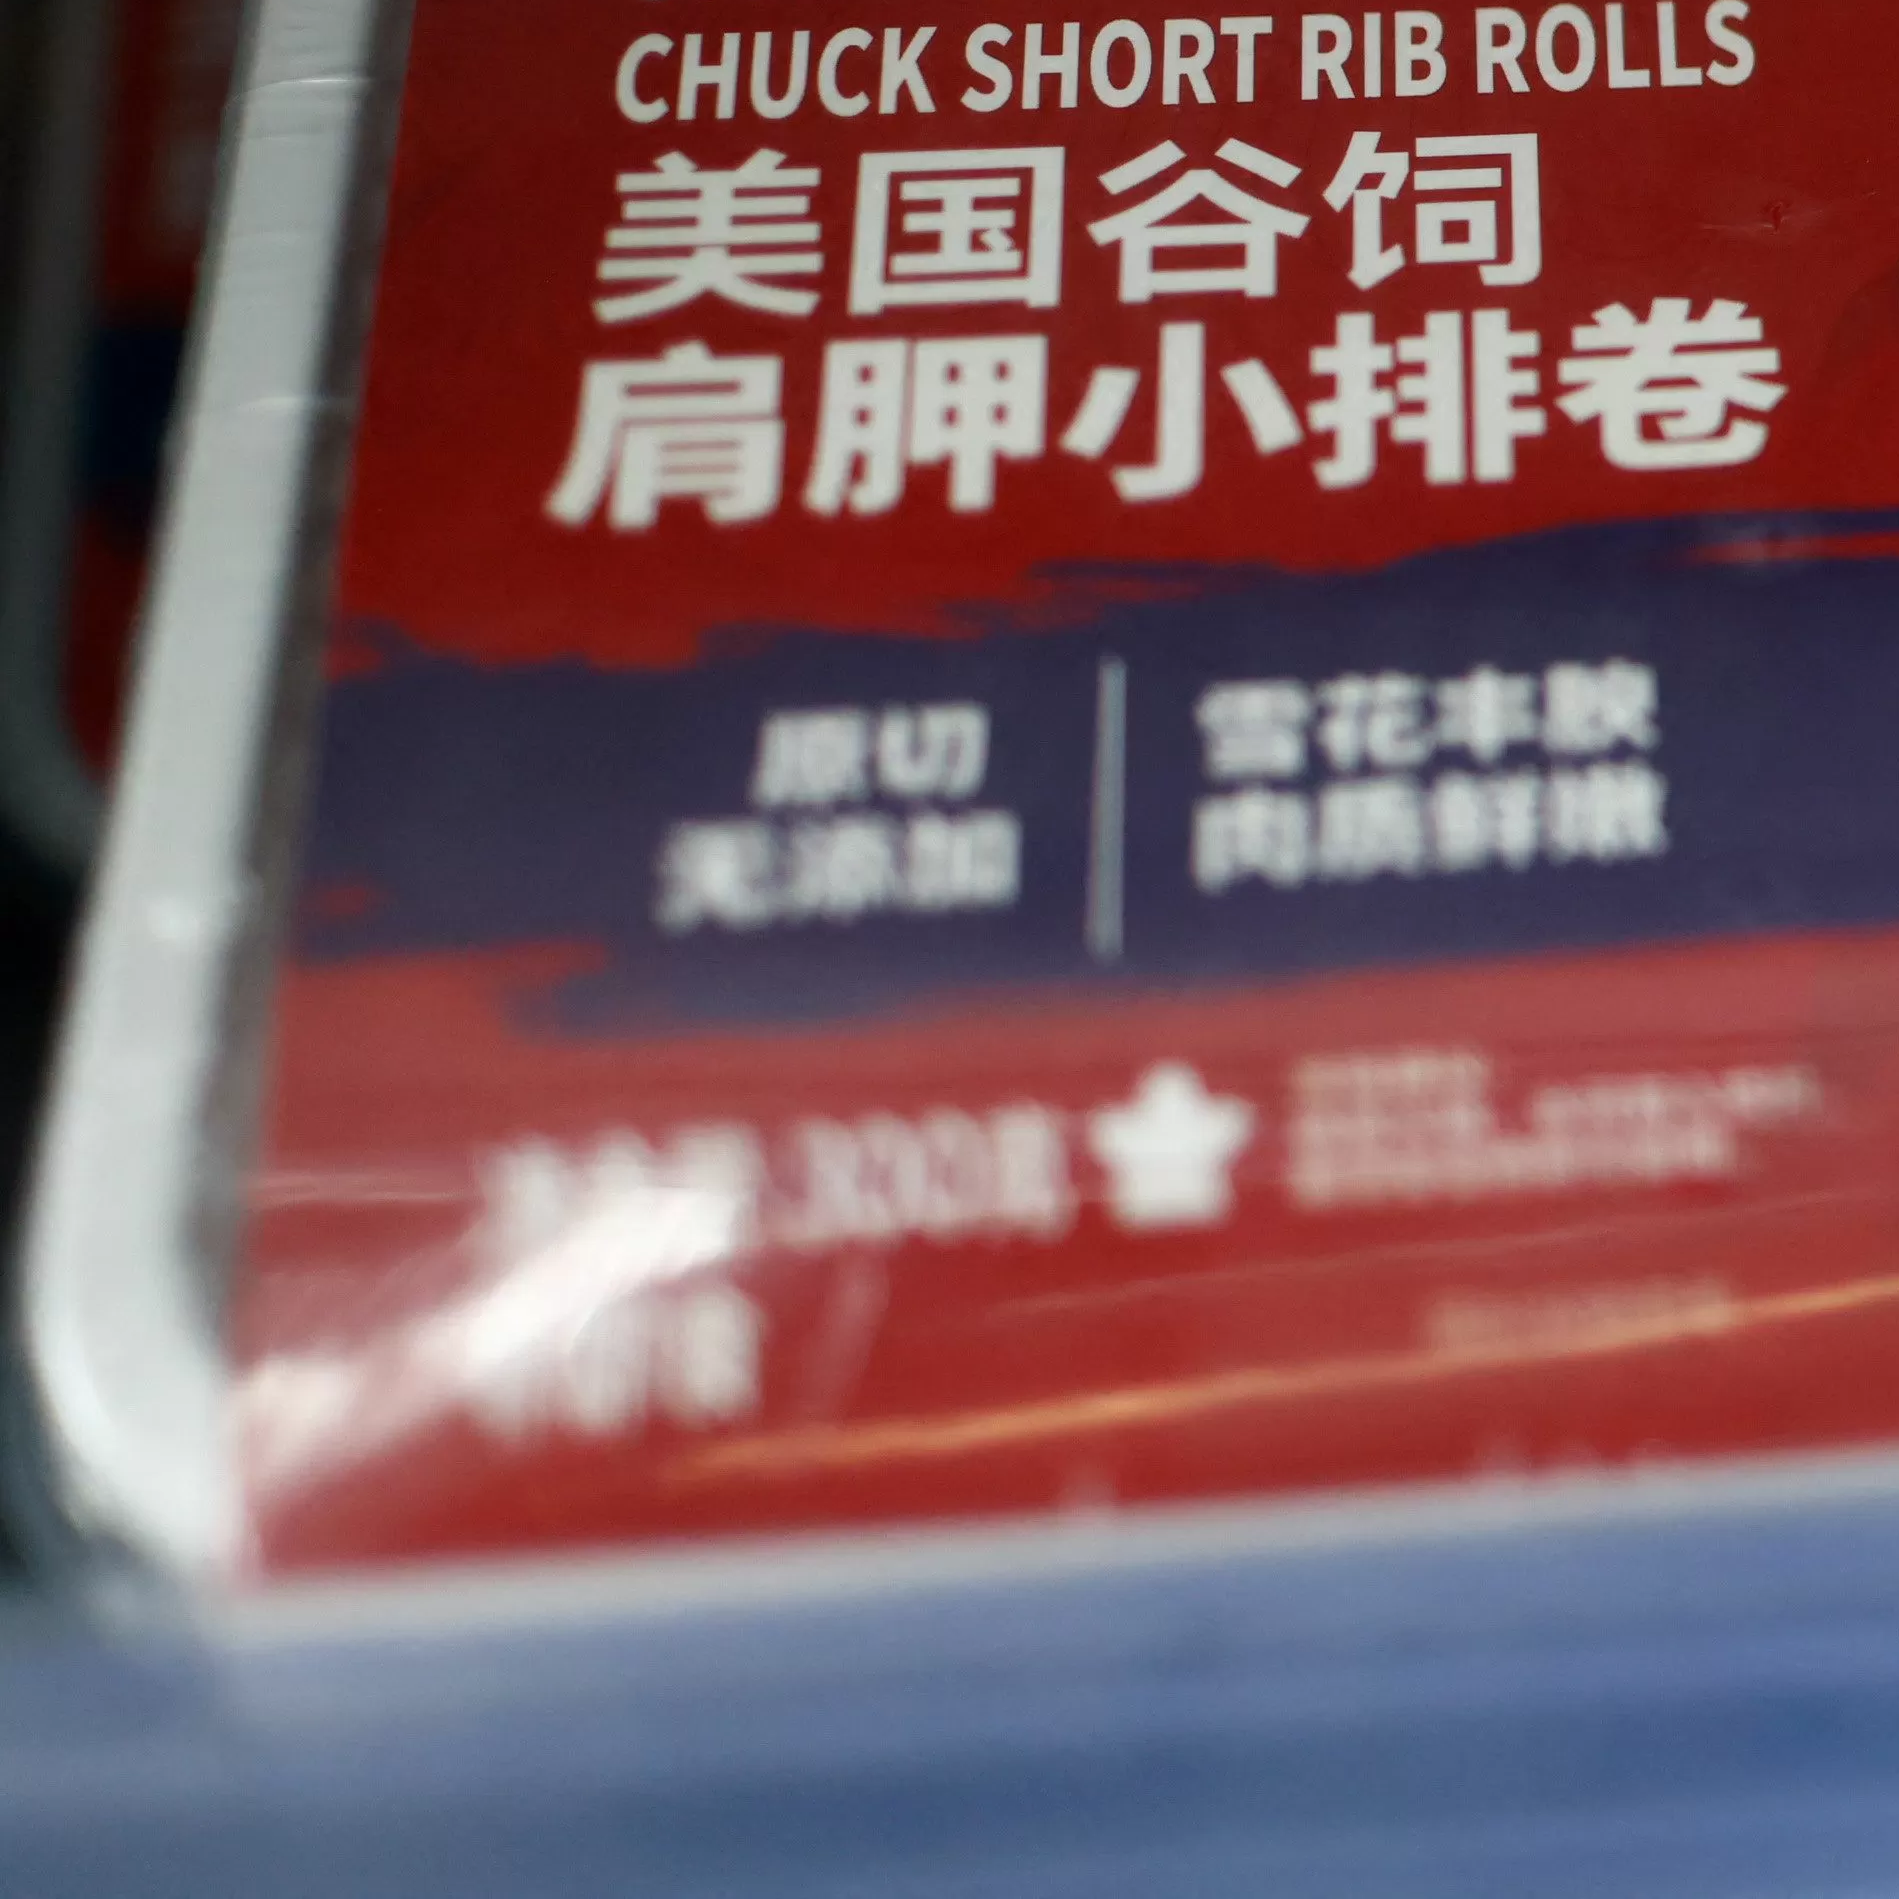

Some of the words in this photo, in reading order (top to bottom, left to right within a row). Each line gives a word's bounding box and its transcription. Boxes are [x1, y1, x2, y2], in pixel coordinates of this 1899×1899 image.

[615, 27, 937, 124] CHUCK
[961, 16, 1274, 113] SHORT
[1300, 10, 1447, 102] RIB
[595, 131, 1542, 324] 美国谷饲
[548, 298, 1788, 530] 肩胛小排卷
